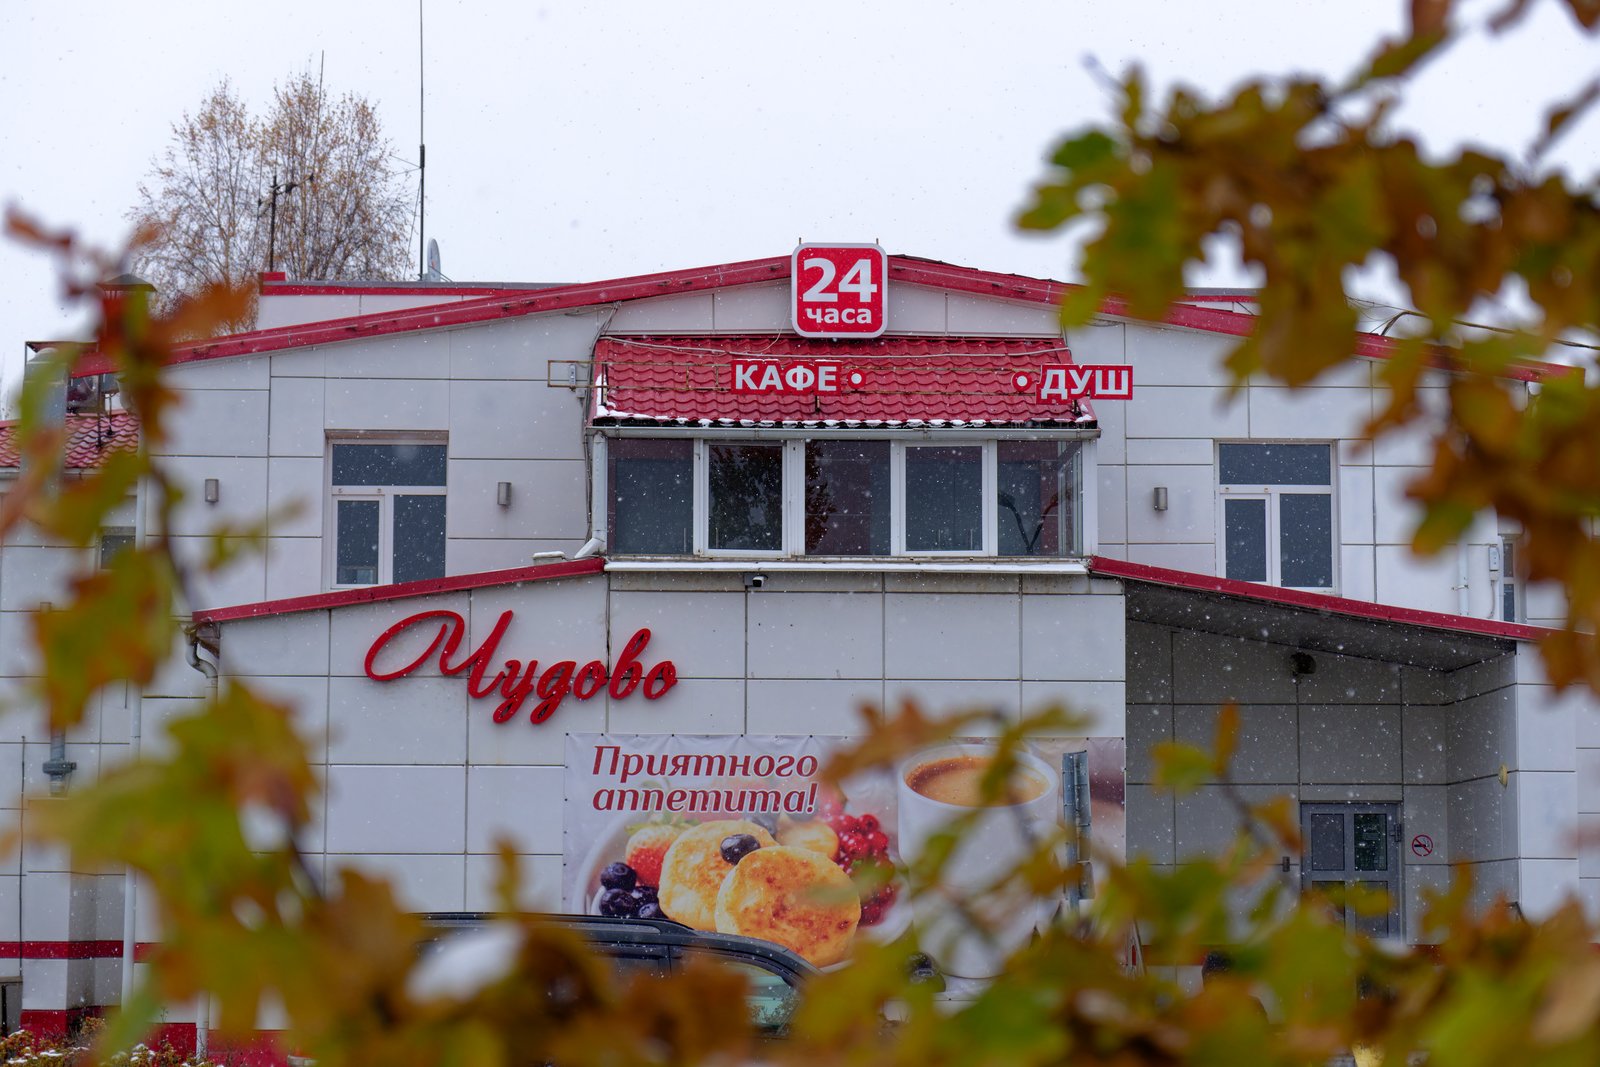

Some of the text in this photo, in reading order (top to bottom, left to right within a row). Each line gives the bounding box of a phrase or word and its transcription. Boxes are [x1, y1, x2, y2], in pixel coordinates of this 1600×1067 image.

[802, 257, 877, 303] 24
[806, 307, 872, 324] часа
[735, 363, 838, 391] КАФЕ
[1040, 369, 1130, 400] ДУШ
[364, 610, 678, 724] Чудово
[592, 745, 818, 783] Приятного
[592, 783, 817, 813] аппетита!
